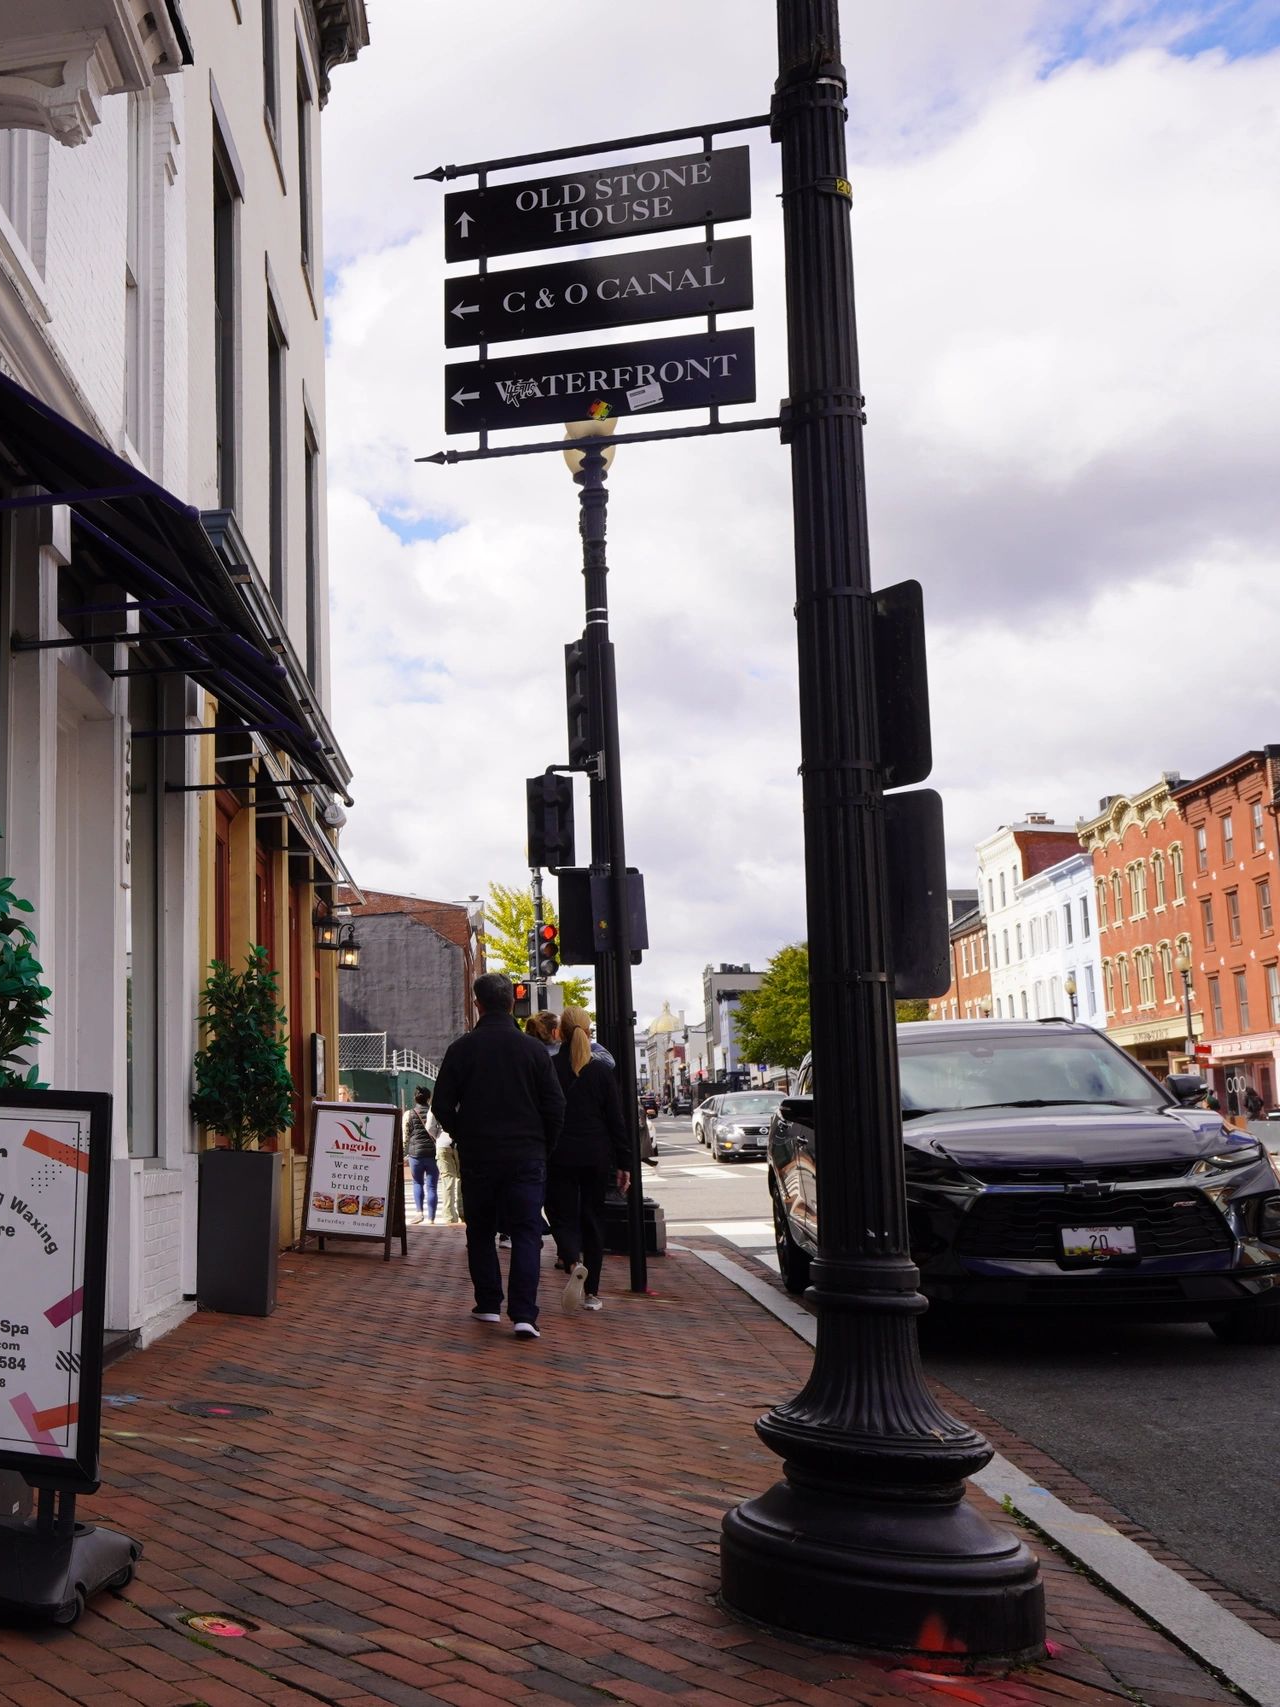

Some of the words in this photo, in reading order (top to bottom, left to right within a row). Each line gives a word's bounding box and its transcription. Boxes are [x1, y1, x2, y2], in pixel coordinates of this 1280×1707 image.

[515, 183, 586, 212] OLD
[595, 162, 713, 200] STONE
[552, 196, 674, 233] HOUSE
[502, 291, 527, 313] C
[535, 287, 556, 310] &
[564, 283, 588, 305] O
[596, 264, 726, 301] CANAL
[331, 1139, 377, 1153] Angolo
[334, 1160, 349, 1170] We
[352, 1163, 370, 1172] are
[331, 1171, 371, 1183] serving
[330, 1182, 369, 1192] brunch
[9, 1195, 59, 1256] Waxing
[317, 1217, 346, 1226] Saturday
[352, 1220, 377, 1229] Sunday
[0, 1319, 30, 1338] Spa
